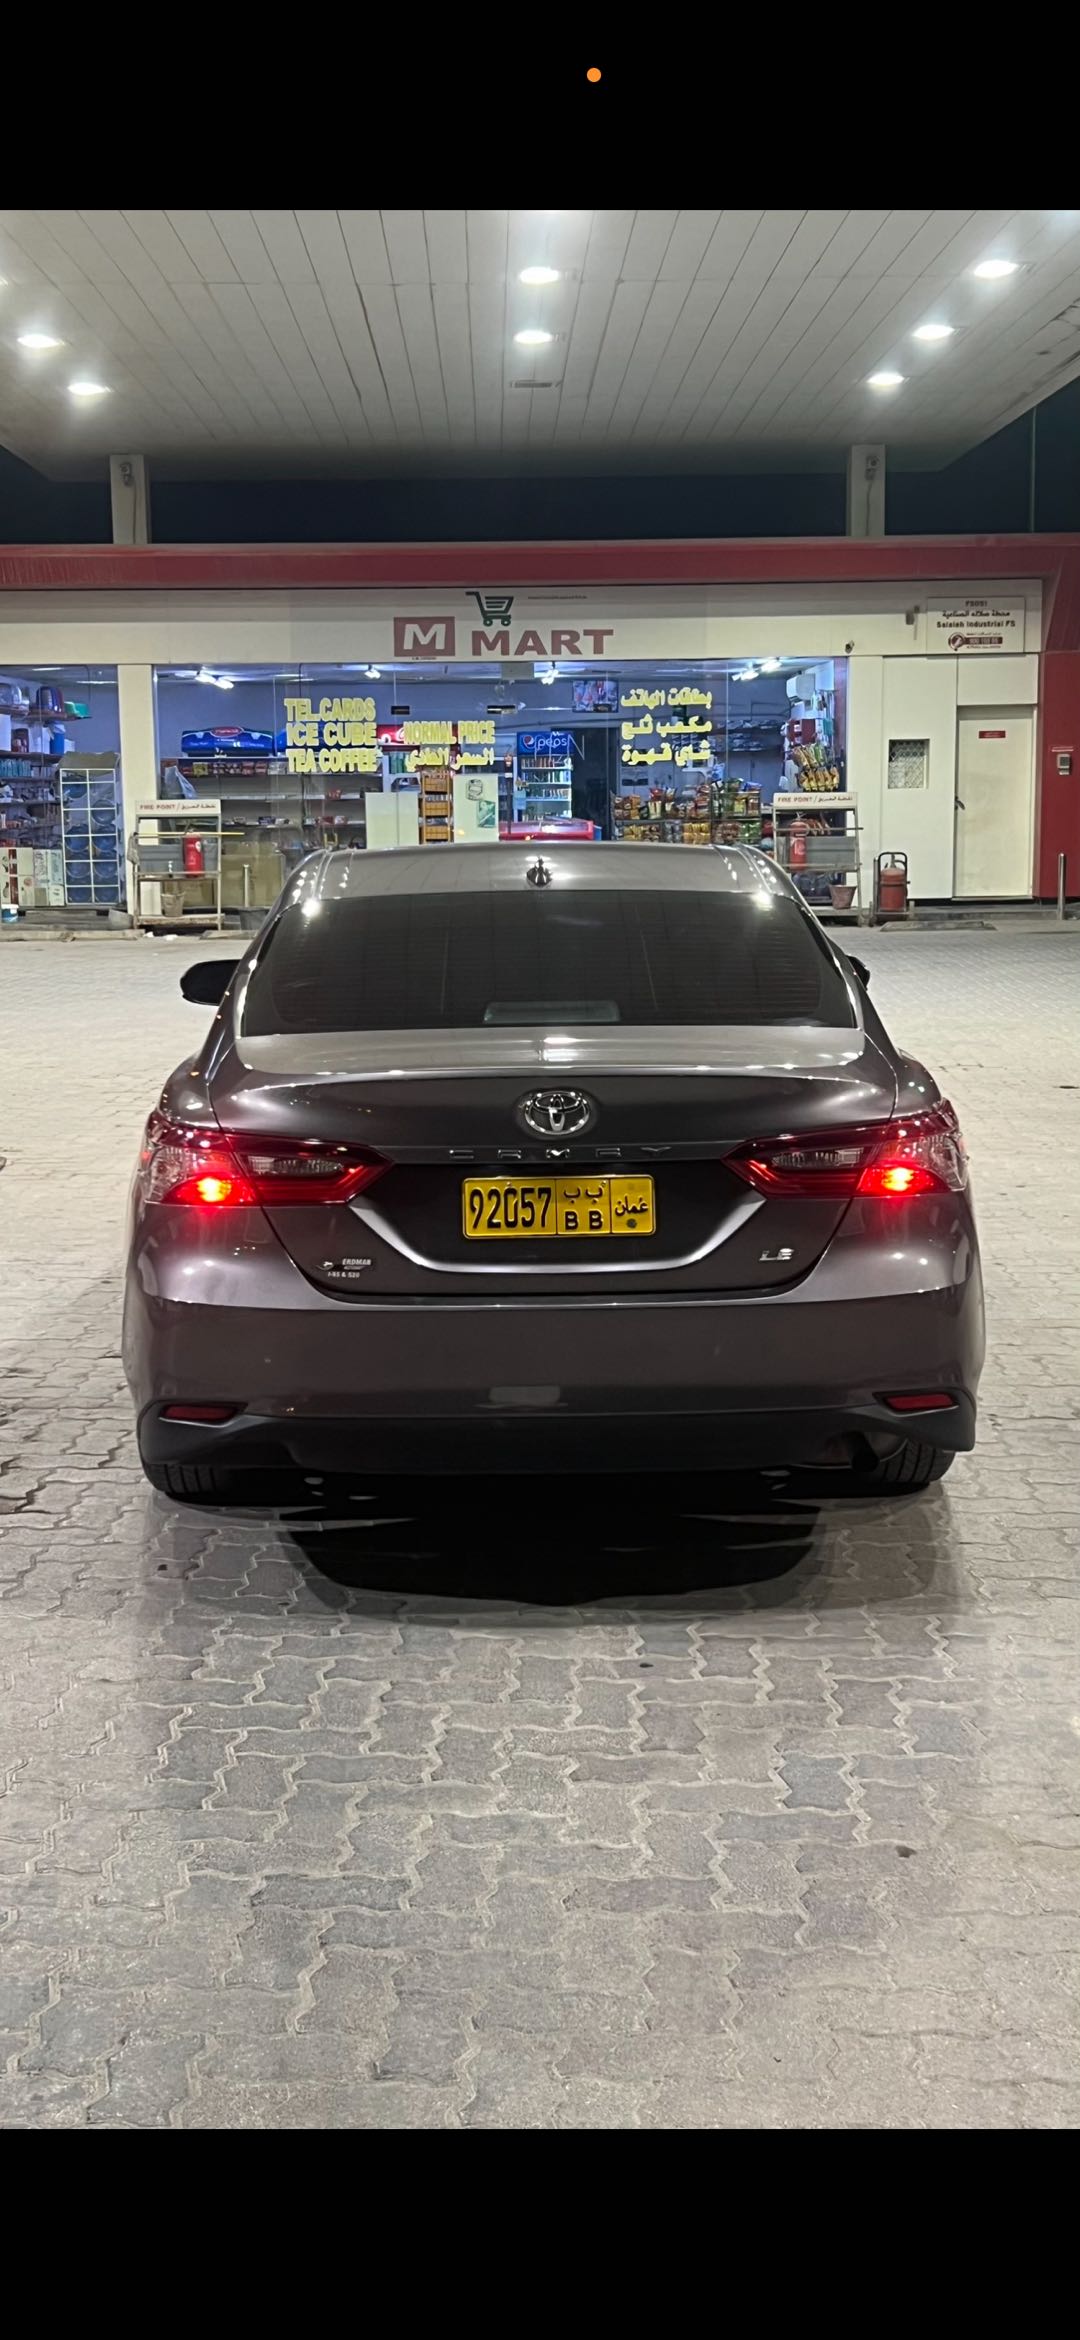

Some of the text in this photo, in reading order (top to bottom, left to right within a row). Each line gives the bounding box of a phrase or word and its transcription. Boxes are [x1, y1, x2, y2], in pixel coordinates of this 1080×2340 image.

[966, 620, 1004, 628] Industrial
[403, 623, 614, 656] M MART
[621, 686, 713, 711] بطاقات الهاتف
[286, 721, 319, 747] ICE
[323, 721, 378, 747] CUBE
[403, 720, 458, 746] NORMAL
[458, 720, 496, 745] PRICE
[656, 715, 713, 738] مكعب
[286, 748, 379, 773] TEA COFFEE
[405, 747, 495, 773] السعر العادي
[621, 739, 711, 767] شاي قهوة
[448, 1146, 672, 1160] CAMRY
[469, 1186, 552, 1230] 92057
[564, 1187, 604, 1205] ب ب
[565, 1209, 603, 1230] B B
[759, 1248, 794, 1261] LE
